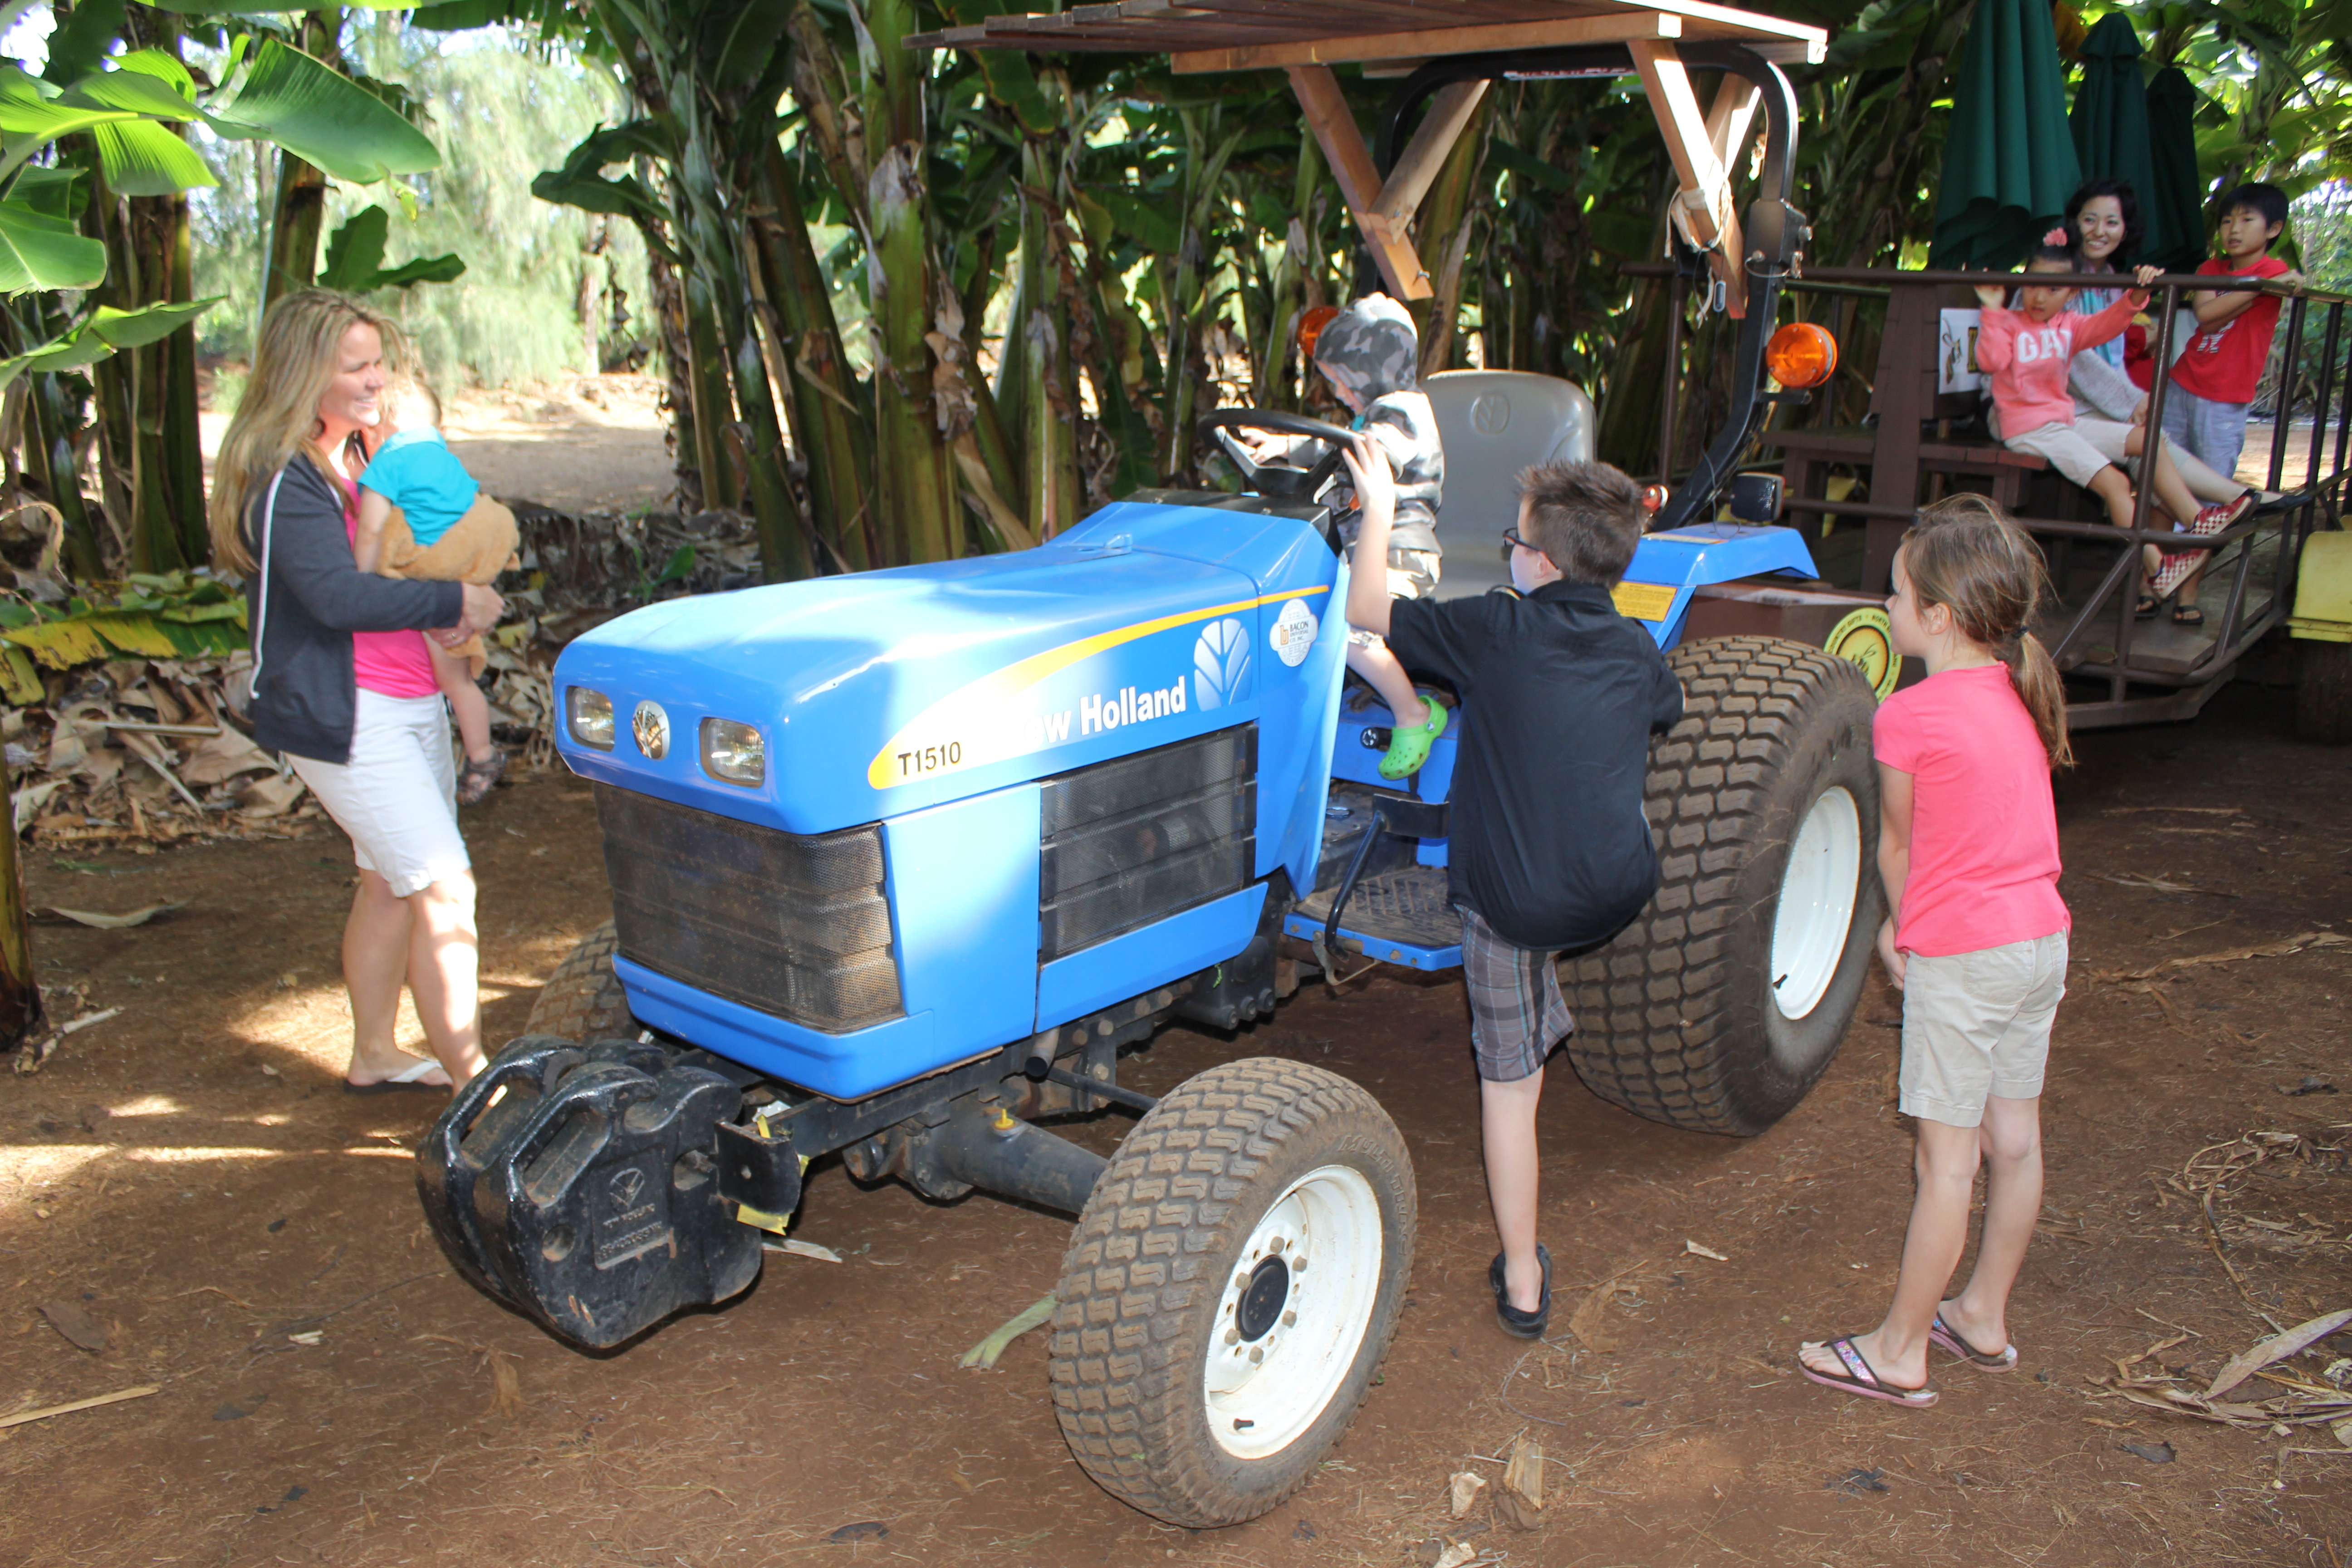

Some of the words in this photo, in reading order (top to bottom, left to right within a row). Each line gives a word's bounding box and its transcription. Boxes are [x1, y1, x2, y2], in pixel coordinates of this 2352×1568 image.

[1289, 621, 1309, 632] BACON
[1024, 710, 1072, 750] ew
[1080, 675, 1186, 736] Holland
[897, 741, 961, 776] T1510
[1338, 1135, 1395, 1173] MULTI
[1390, 1173, 1408, 1256] TRAC
